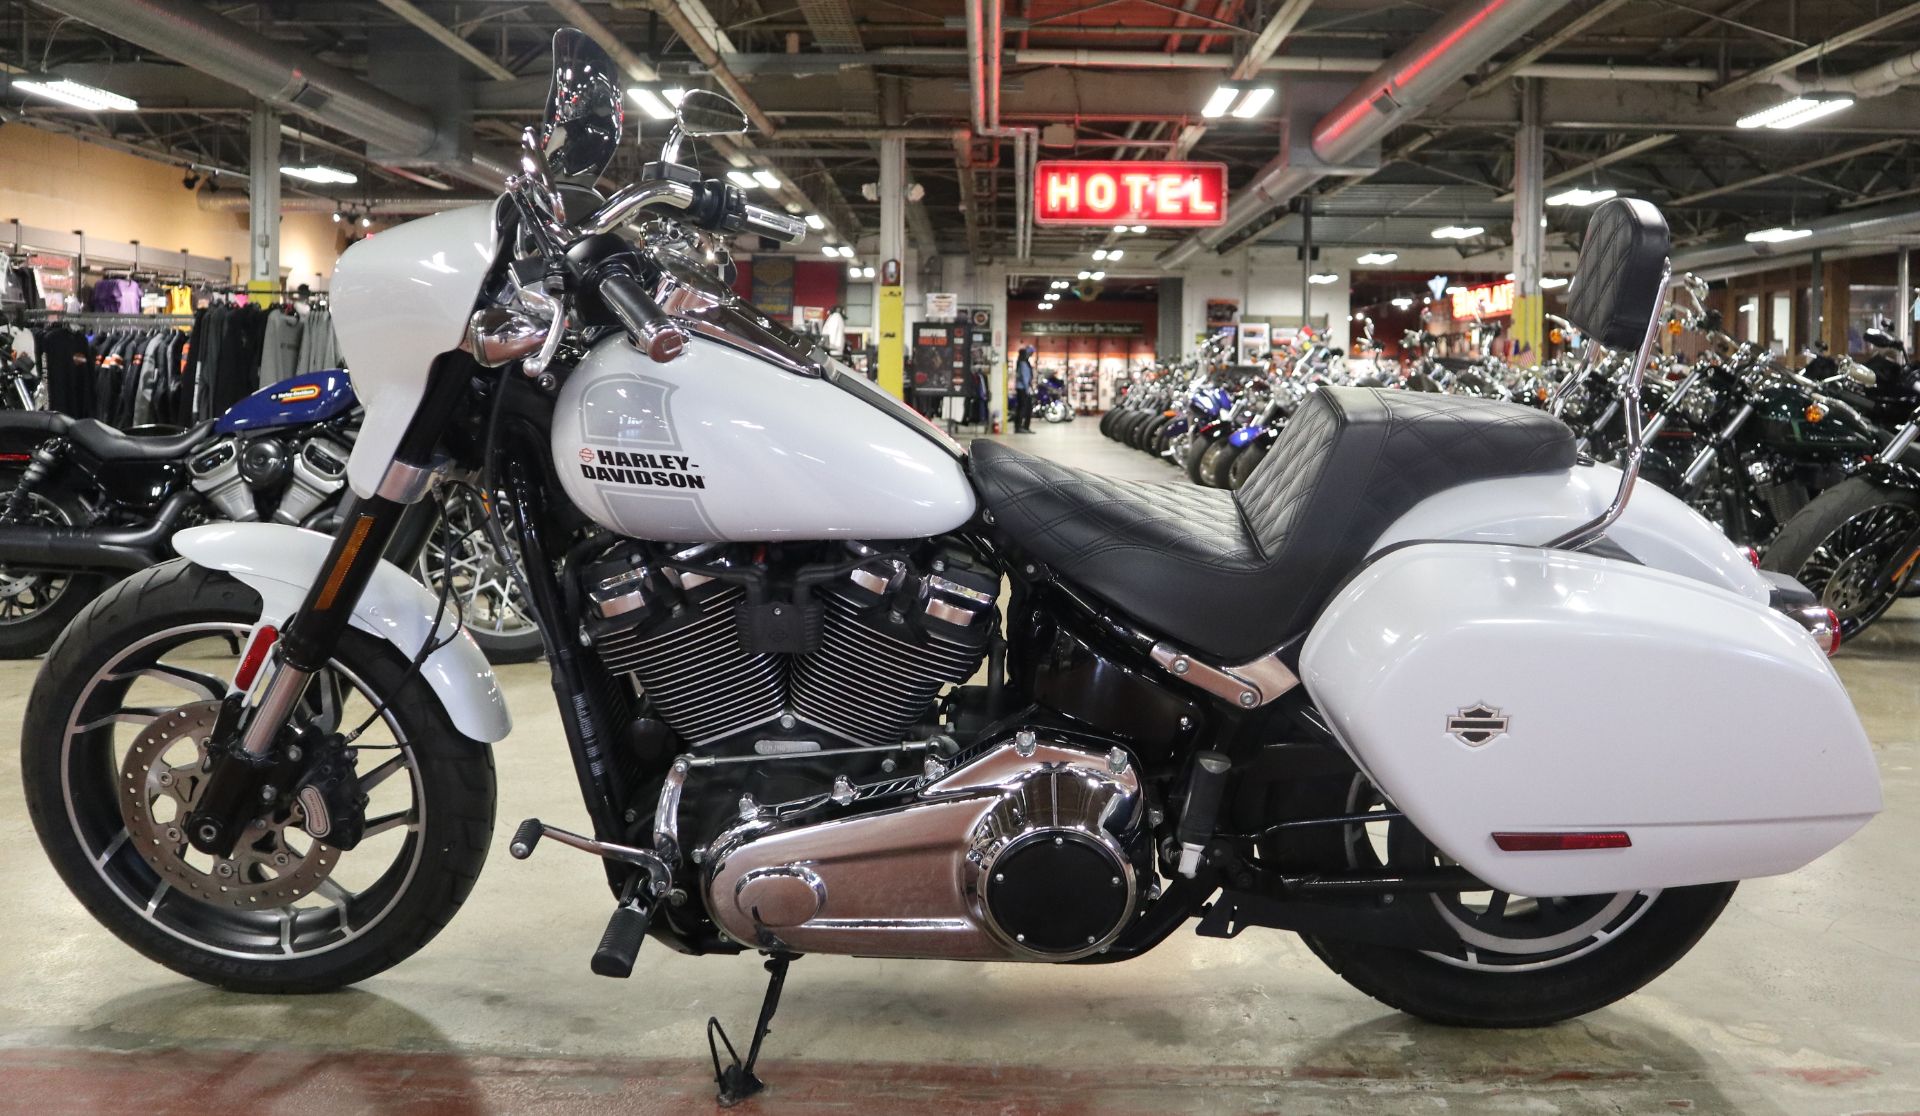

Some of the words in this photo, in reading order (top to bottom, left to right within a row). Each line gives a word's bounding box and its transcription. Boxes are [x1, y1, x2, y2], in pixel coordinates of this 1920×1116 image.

[1047, 172, 1216, 213] HOTEL
[597, 449, 699, 471] HARLEY-
[580, 463, 706, 489] DAVIDSON
